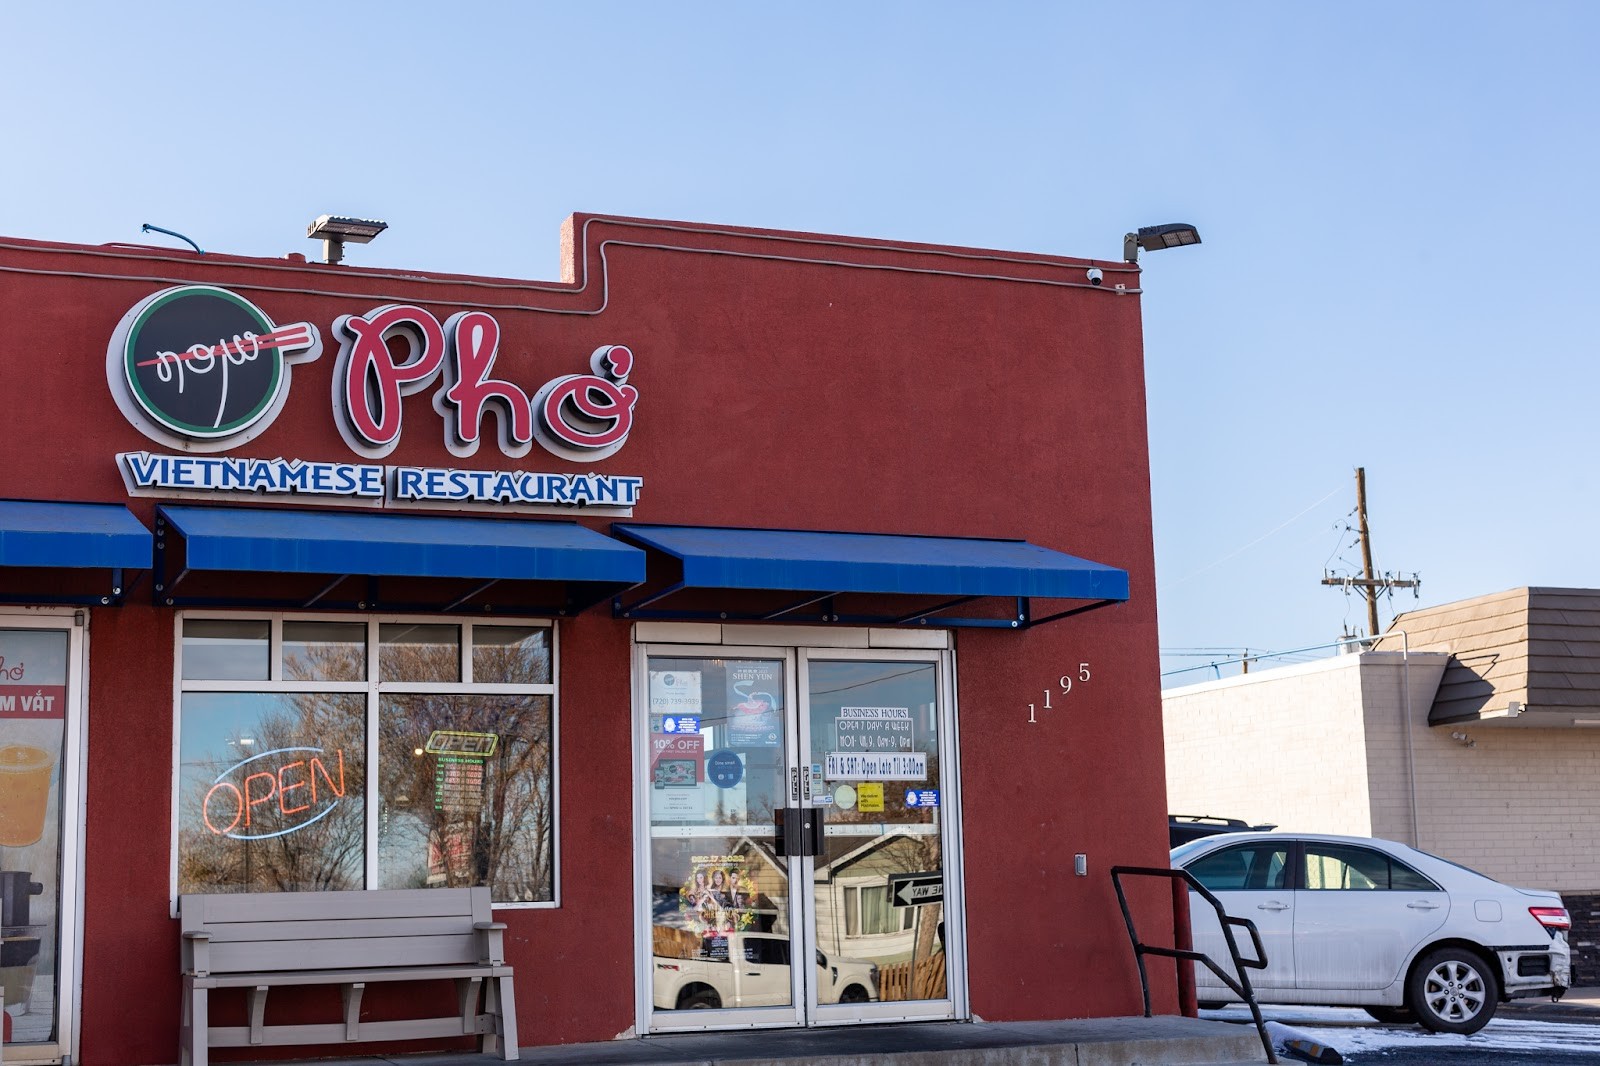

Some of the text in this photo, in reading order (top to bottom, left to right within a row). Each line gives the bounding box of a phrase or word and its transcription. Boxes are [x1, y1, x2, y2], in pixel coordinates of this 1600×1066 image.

[131, 455, 639, 503] VIETNAMESE RESTAURANT
[732, 672, 754, 680] SHEN
[20, 689, 55, 712] VẮT
[652, 697, 669, 706] (720)
[1027, 662, 1091, 723] 1195
[842, 708, 907, 719] BUSINESS HOURS
[860, 720, 865, 731] 7
[884, 720, 890, 731] A
[430, 734, 493, 753] OPEN
[653, 739, 700, 750] 10% OFF
[828, 757, 838, 775] FRI
[840, 757, 845, 775] &
[861, 757, 877, 779] Open
[879, 757, 892, 775] Late
[203, 749, 345, 835] OPEN
